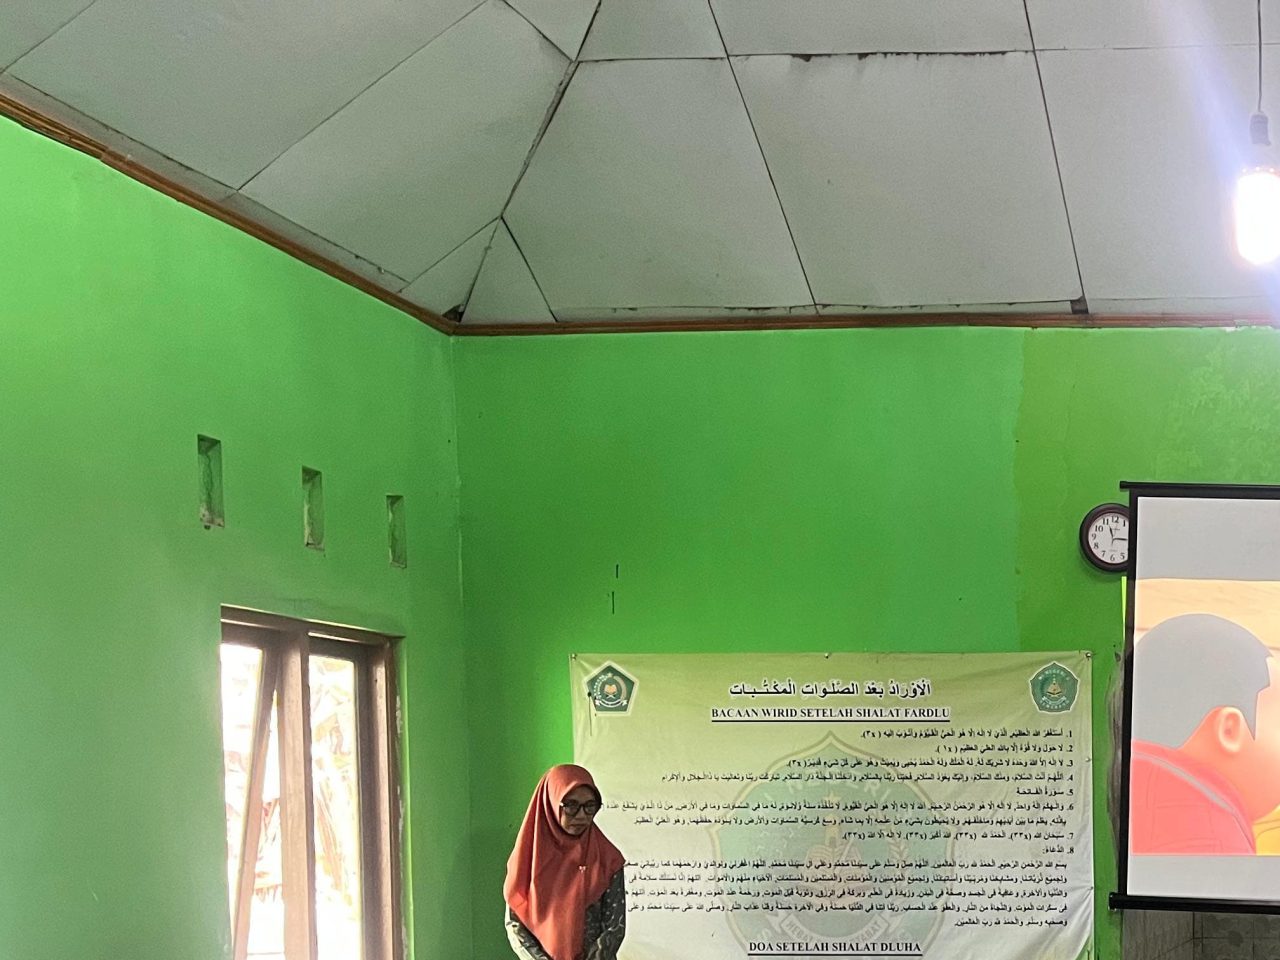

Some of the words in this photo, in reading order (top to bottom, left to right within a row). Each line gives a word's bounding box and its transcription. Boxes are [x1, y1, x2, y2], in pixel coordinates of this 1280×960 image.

[1112, 516, 1119, 524] 12
[1094, 542, 1099, 550] 8
[1101, 550, 1106, 558] 7
[1110, 554, 1116, 562] 6
[1120, 552, 1125, 560] 5
[712, 708, 758, 718] BACAAN
[761, 708, 797, 718] WIRID
[800, 708, 853, 718] SETELAH
[856, 708, 901, 718] SHALAT
[904, 708, 950, 718] FARDLU
[750, 942, 774, 952] DOA
[776, 942, 828, 952] SETELAH
[832, 942, 876, 952] SHALAT
[880, 942, 921, 952] DLUHA
